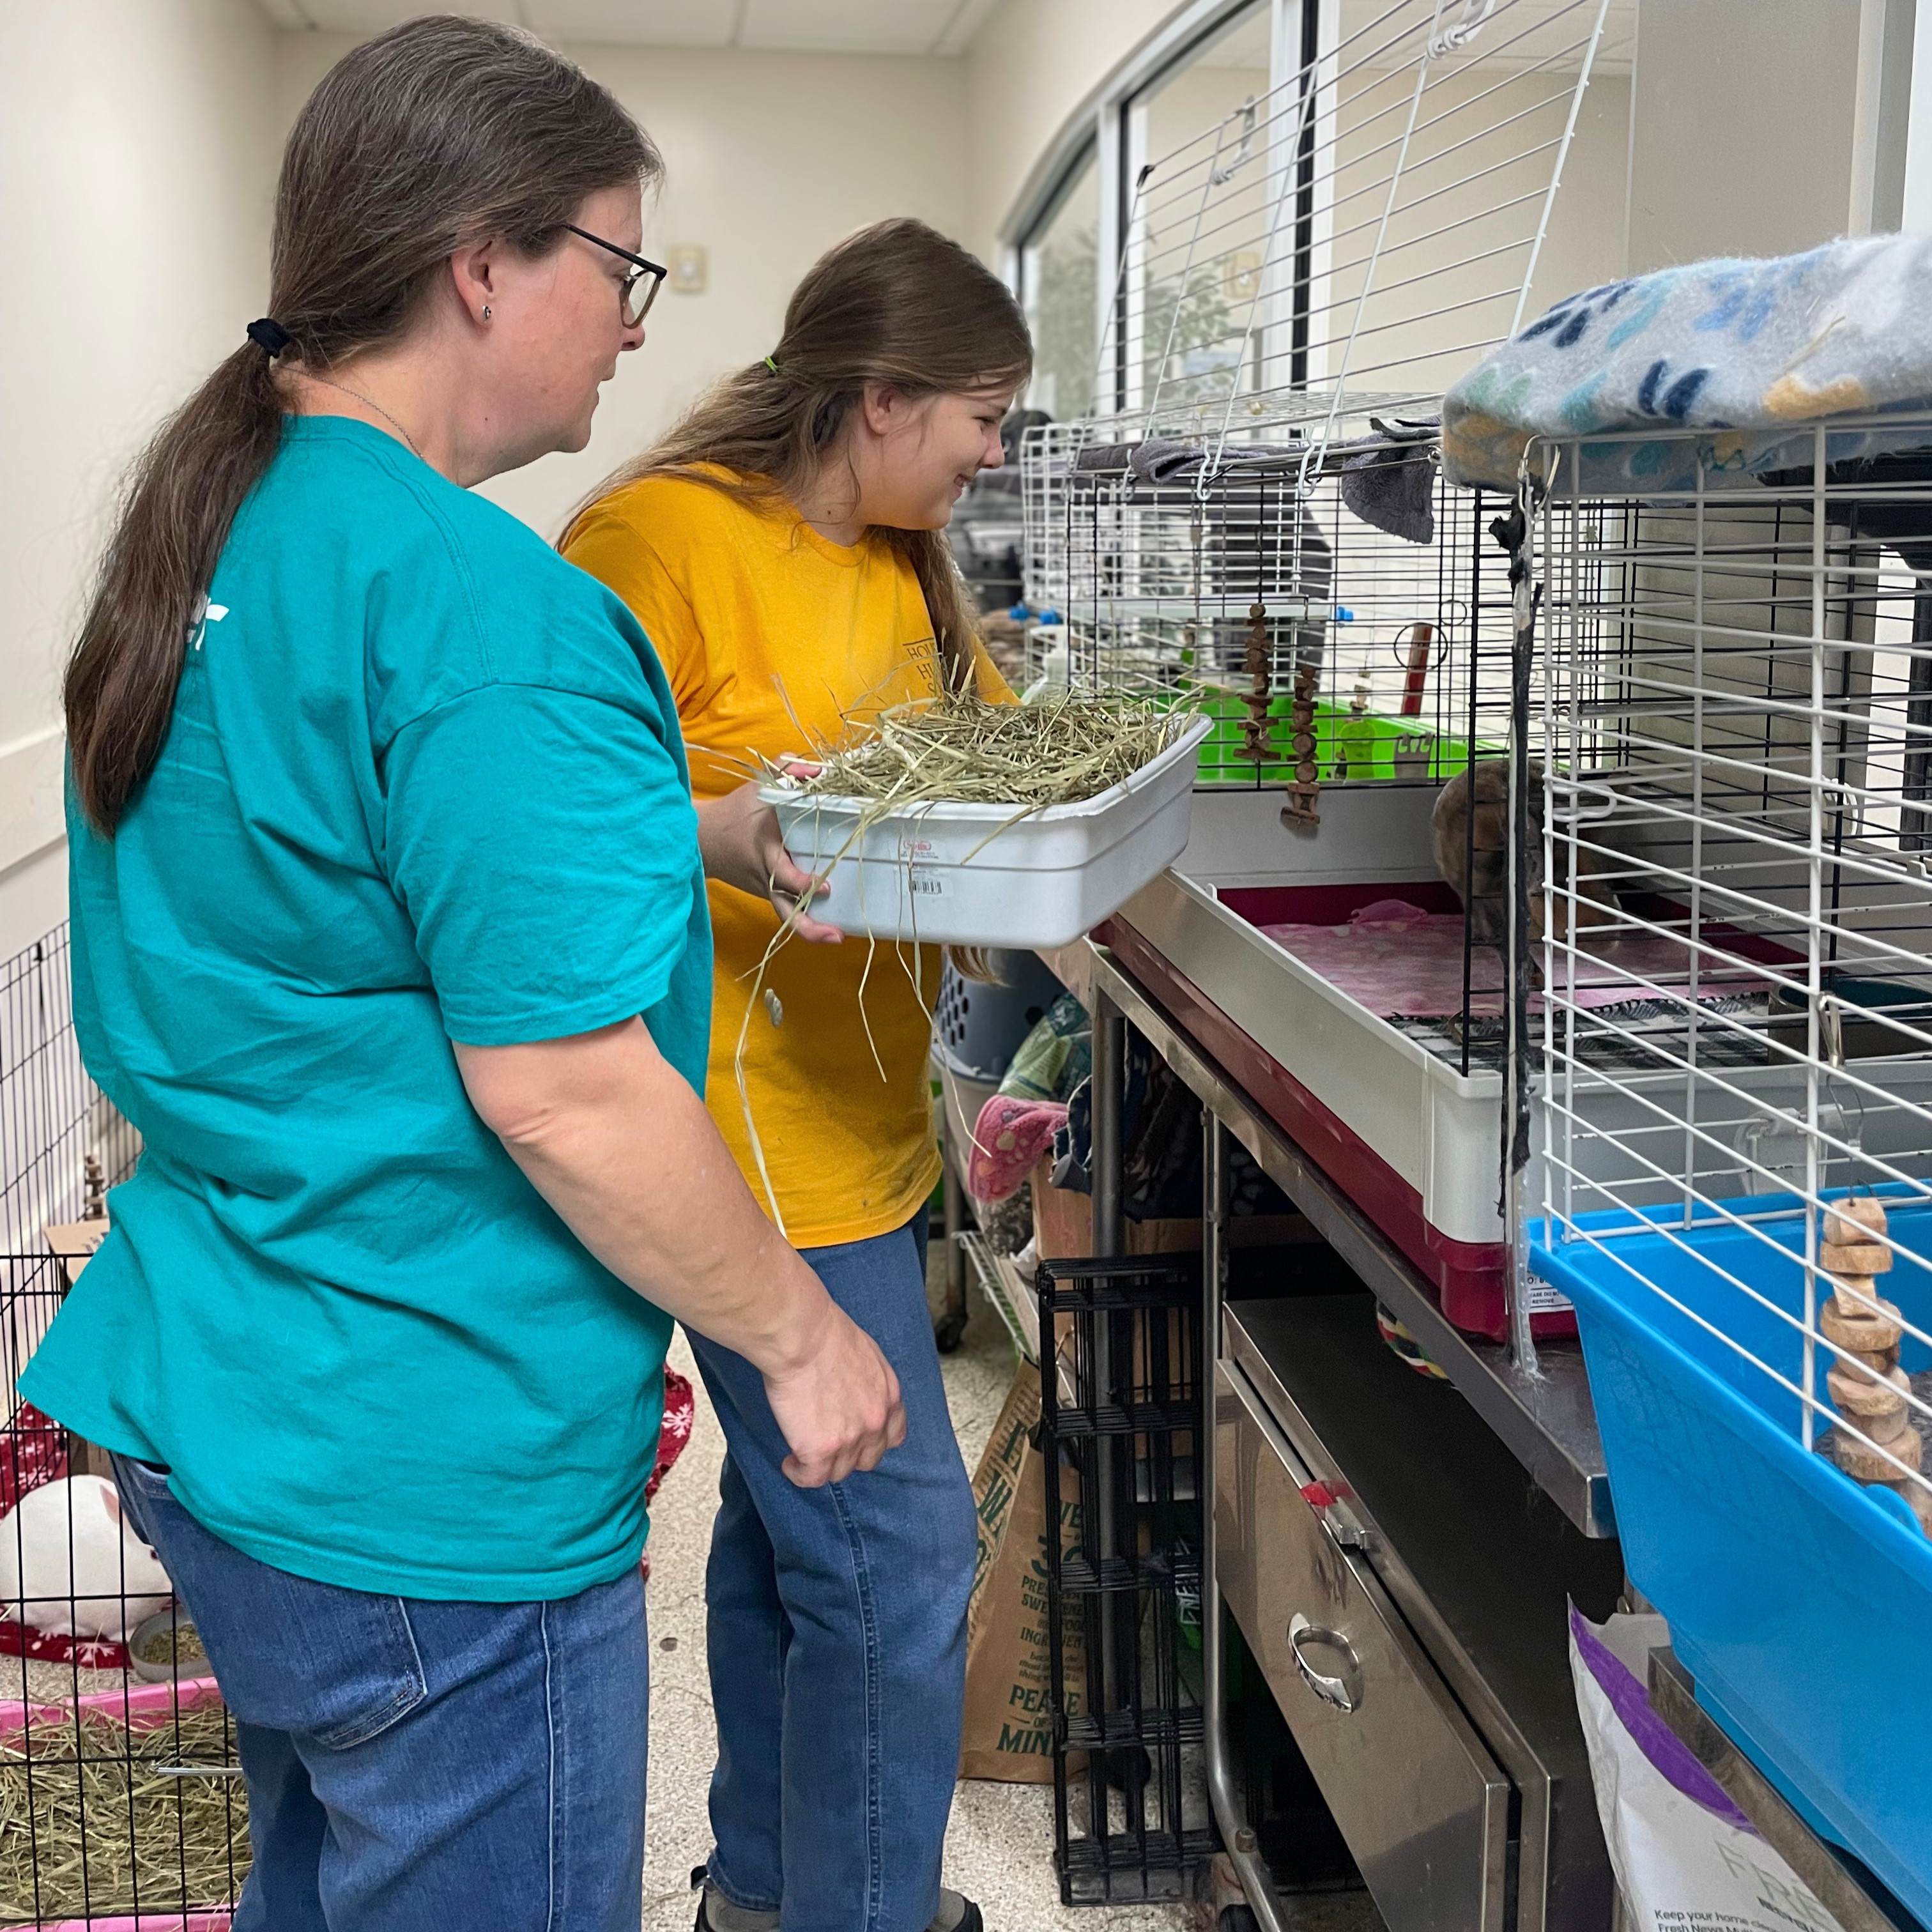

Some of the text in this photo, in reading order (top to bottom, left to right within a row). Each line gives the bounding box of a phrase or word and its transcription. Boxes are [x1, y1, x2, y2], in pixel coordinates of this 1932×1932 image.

[1008, 1683, 1081, 1717] PEAE
[995, 1723, 1054, 1758] MIN
[1654, 1909, 1685, 1922] Keep
[1686, 1912, 1713, 1922] your
[1715, 1911, 1749, 1926] home
